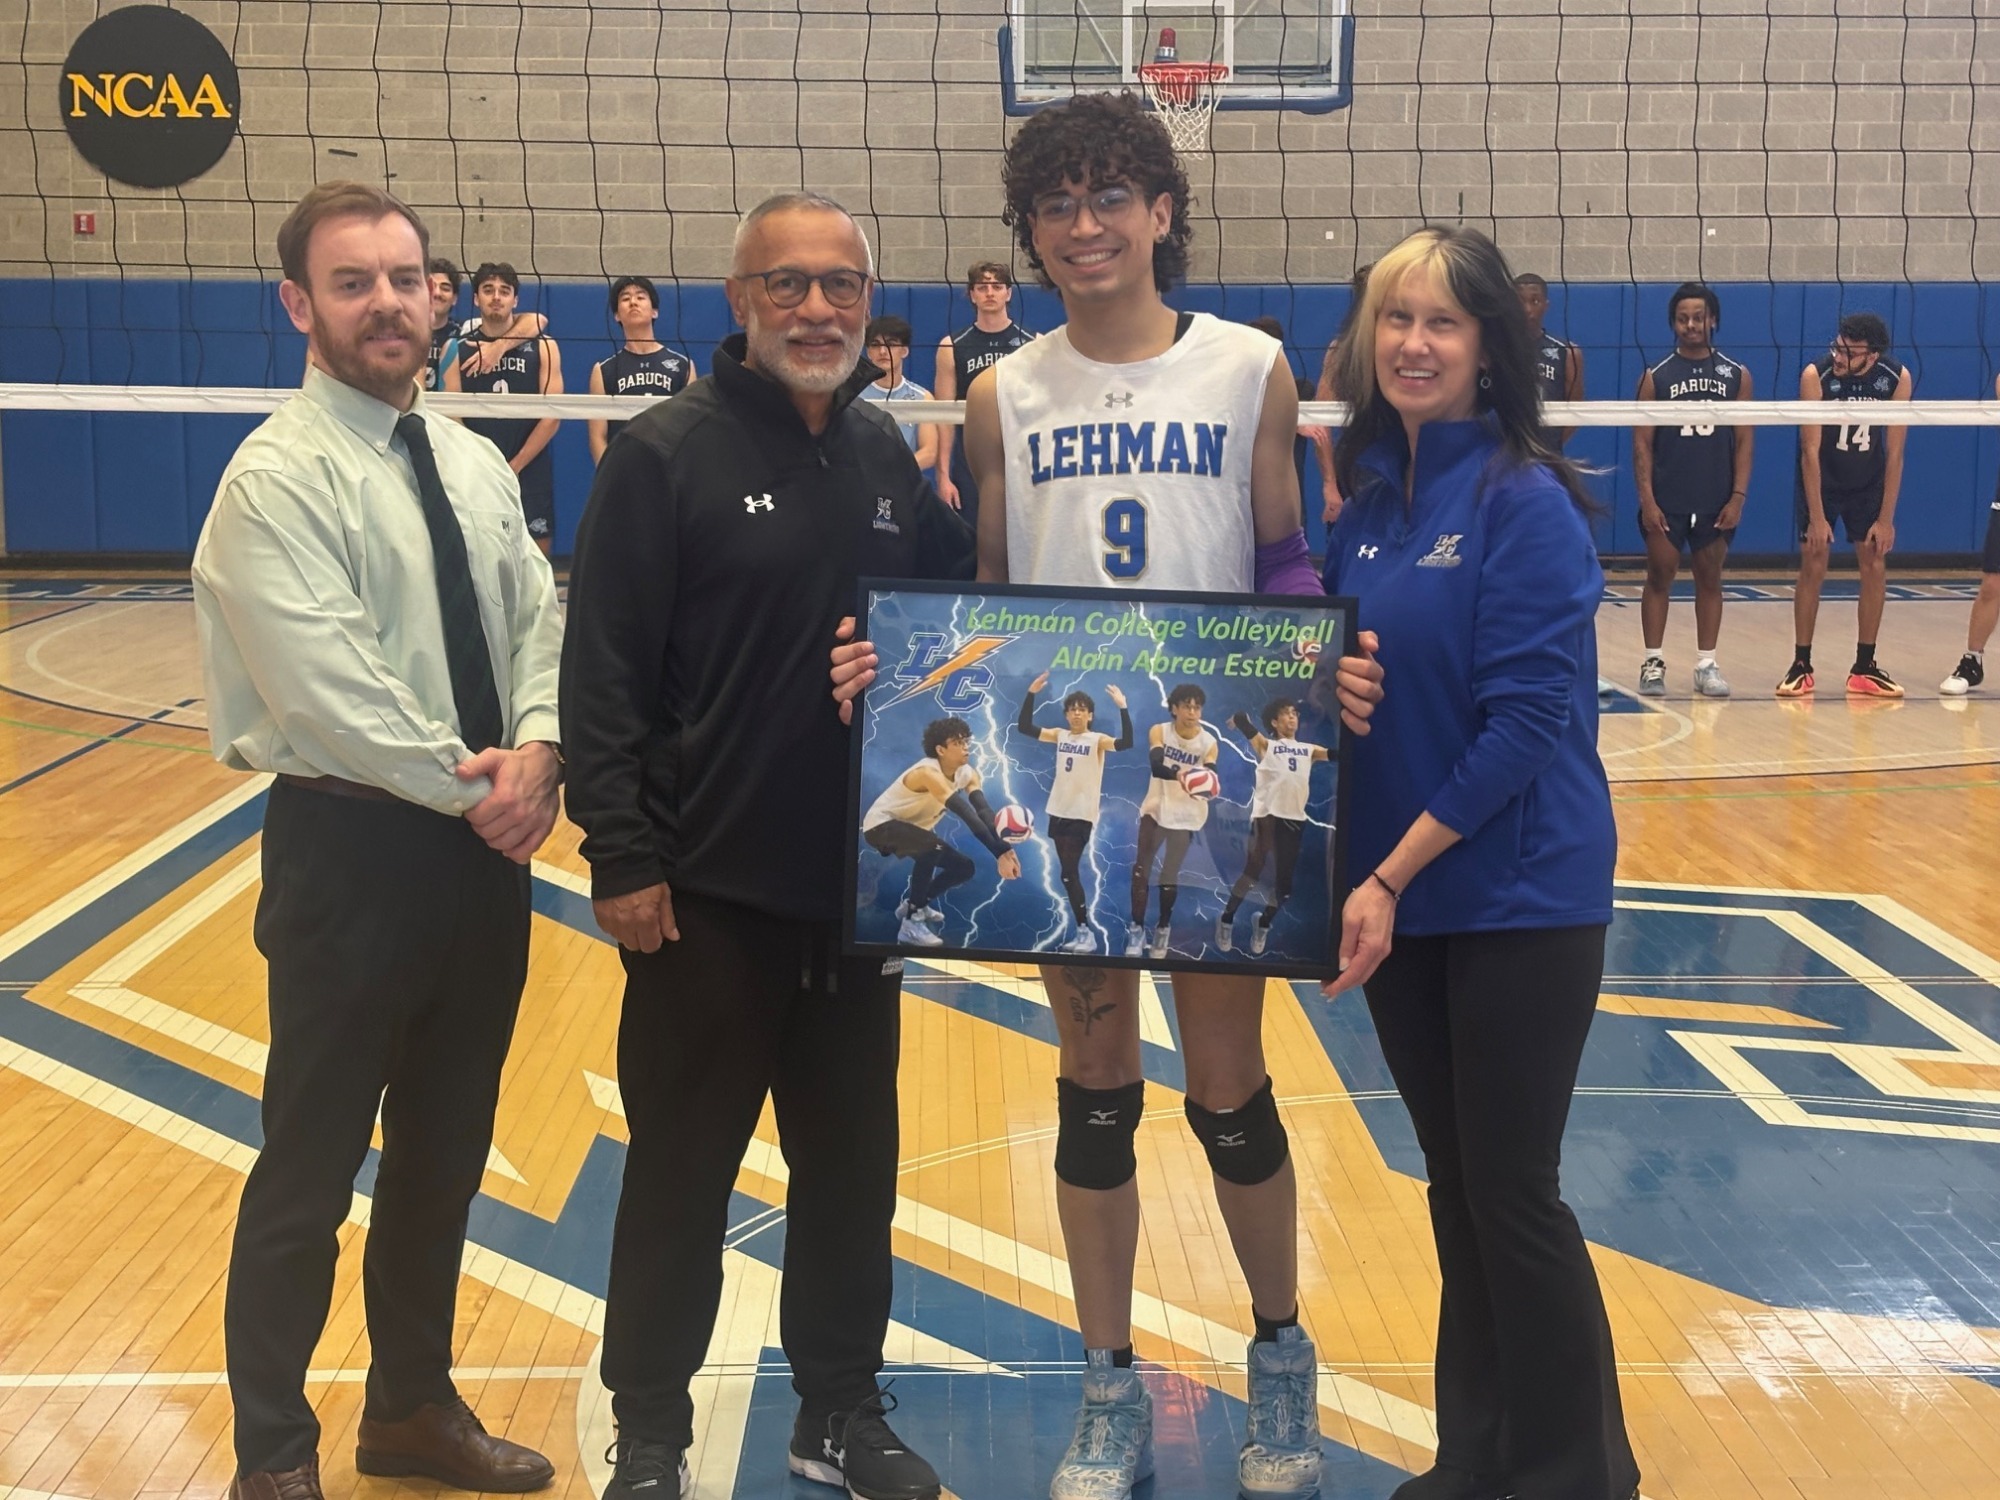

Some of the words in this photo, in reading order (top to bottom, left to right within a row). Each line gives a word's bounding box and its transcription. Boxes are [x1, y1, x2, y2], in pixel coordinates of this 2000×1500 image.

[66, 72, 232, 118] NCAA
[966, 351, 1008, 375] BAR
[617, 370, 673, 393] BARUCH
[1669, 378, 1727, 399] BARUCH
[1028, 421, 1227, 487] LEHMAN
[1101, 496, 1148, 582] 9
[966, 607, 1076, 633] Lehman
[1084, 611, 1188, 640] College
[1197, 616, 1335, 647] Volleyball
[1050, 646, 1123, 672] Alain
[1131, 649, 1217, 676] Abreu
[1224, 653, 1317, 680] Esteva
[1065, 757, 1074, 773] 9
[1288, 757, 1297, 772] 9
